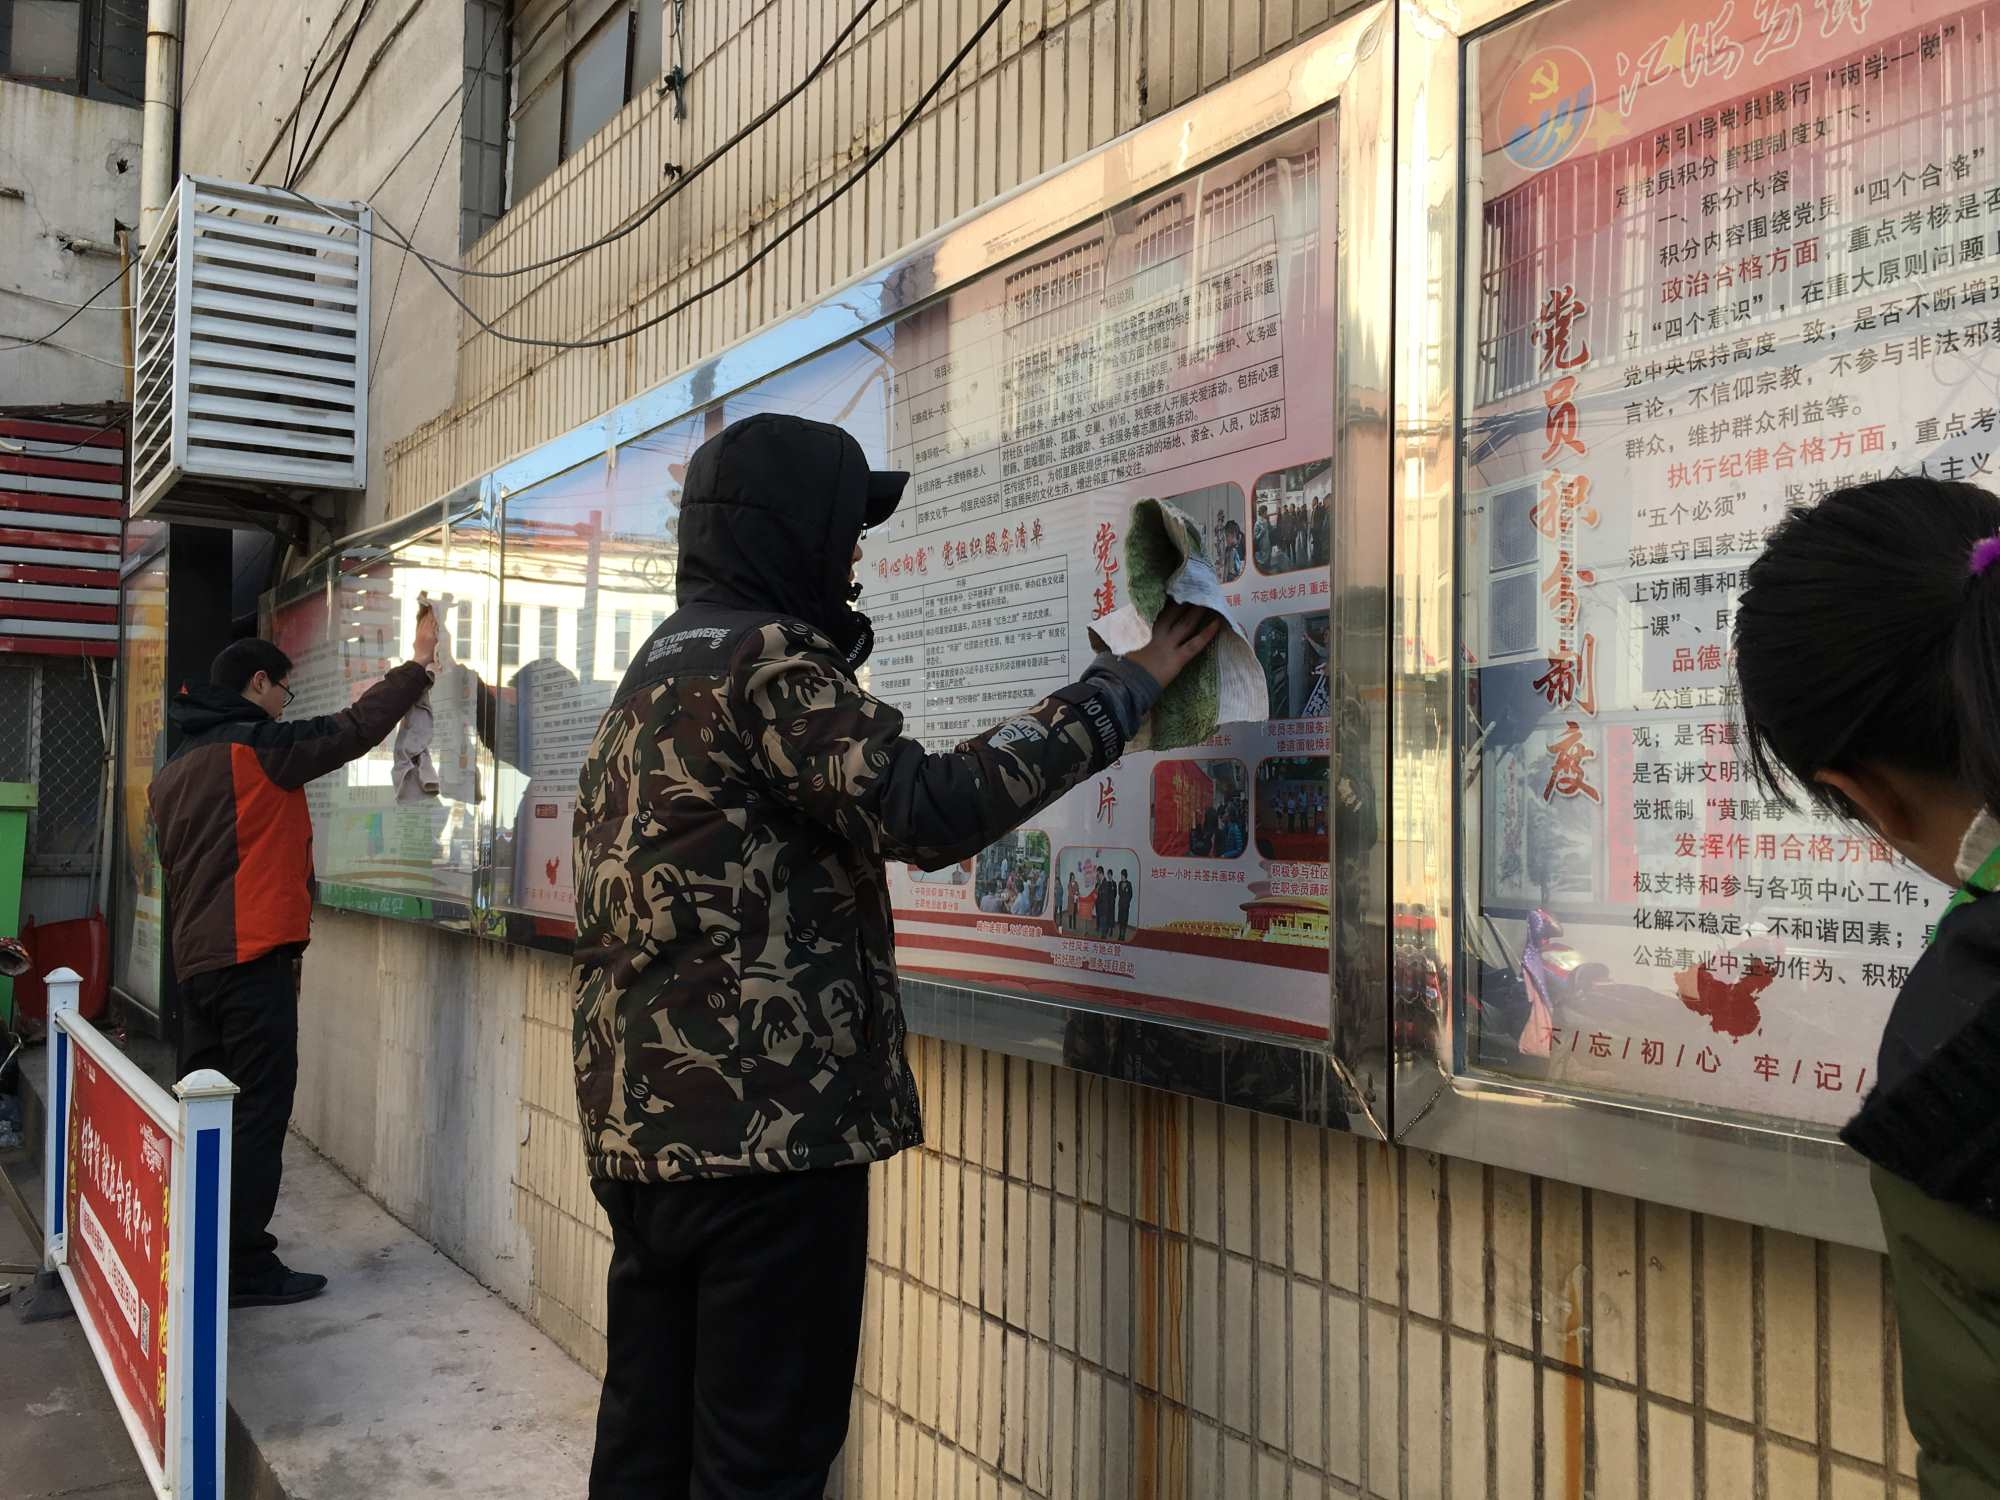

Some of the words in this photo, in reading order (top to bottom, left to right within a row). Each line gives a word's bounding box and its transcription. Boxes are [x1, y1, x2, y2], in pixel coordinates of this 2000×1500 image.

[1625, 393, 1864, 460] 群众，维护群众利益等。
